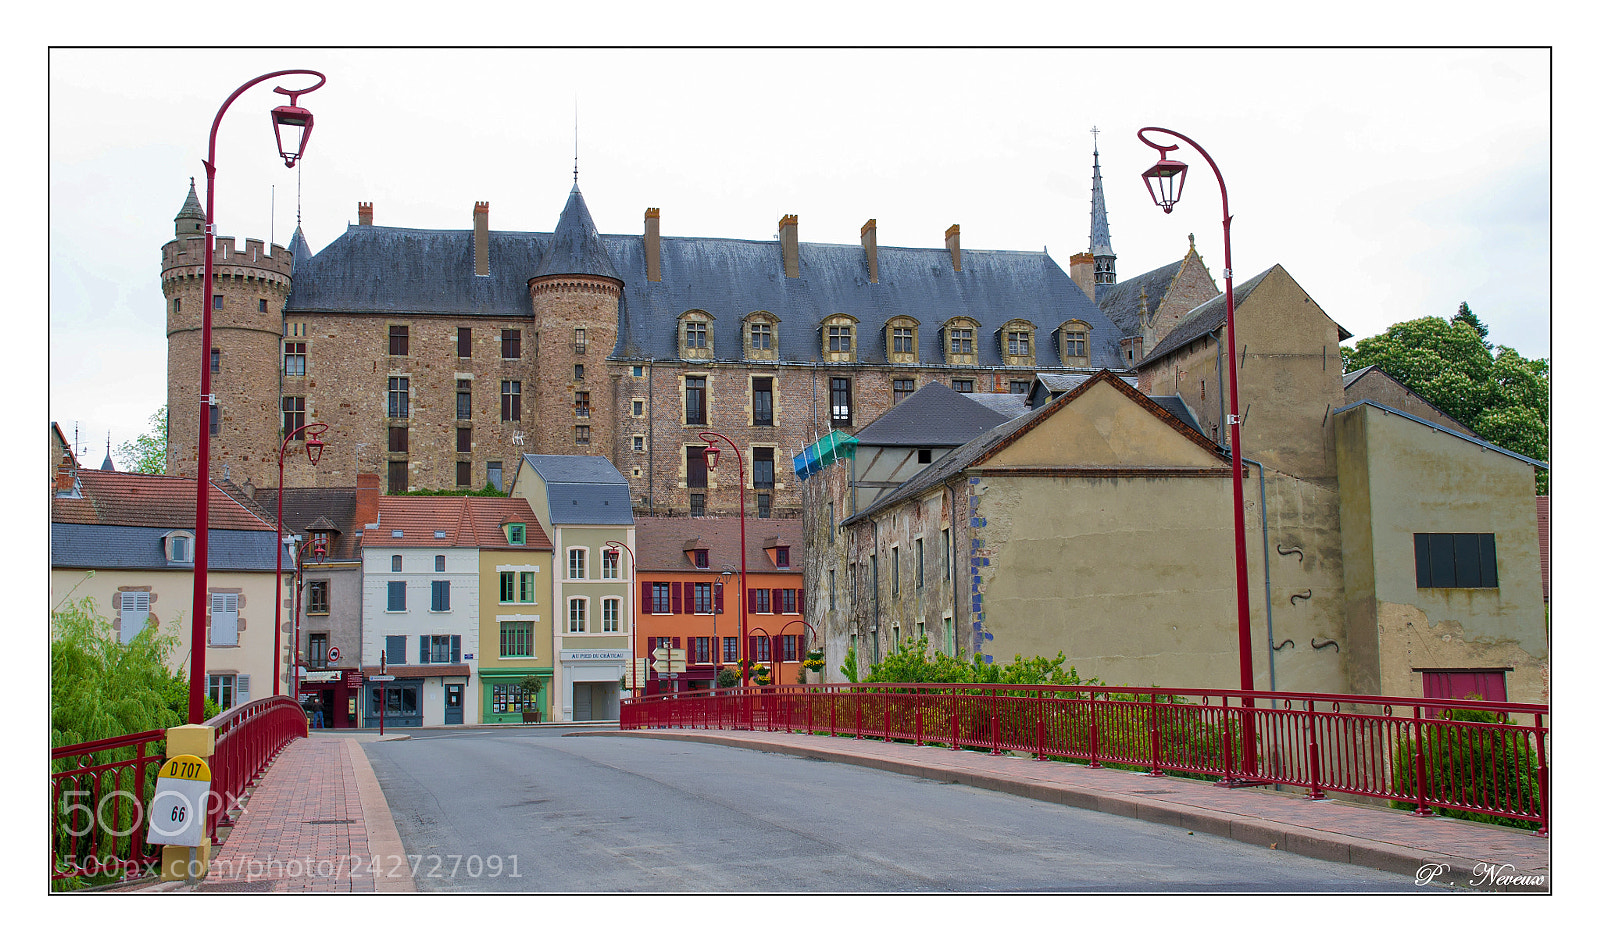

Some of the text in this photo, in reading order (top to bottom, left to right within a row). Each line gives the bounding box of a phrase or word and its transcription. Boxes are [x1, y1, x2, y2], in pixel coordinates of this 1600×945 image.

[170, 761, 202, 779] D 707
[171, 806, 186, 823] 66
